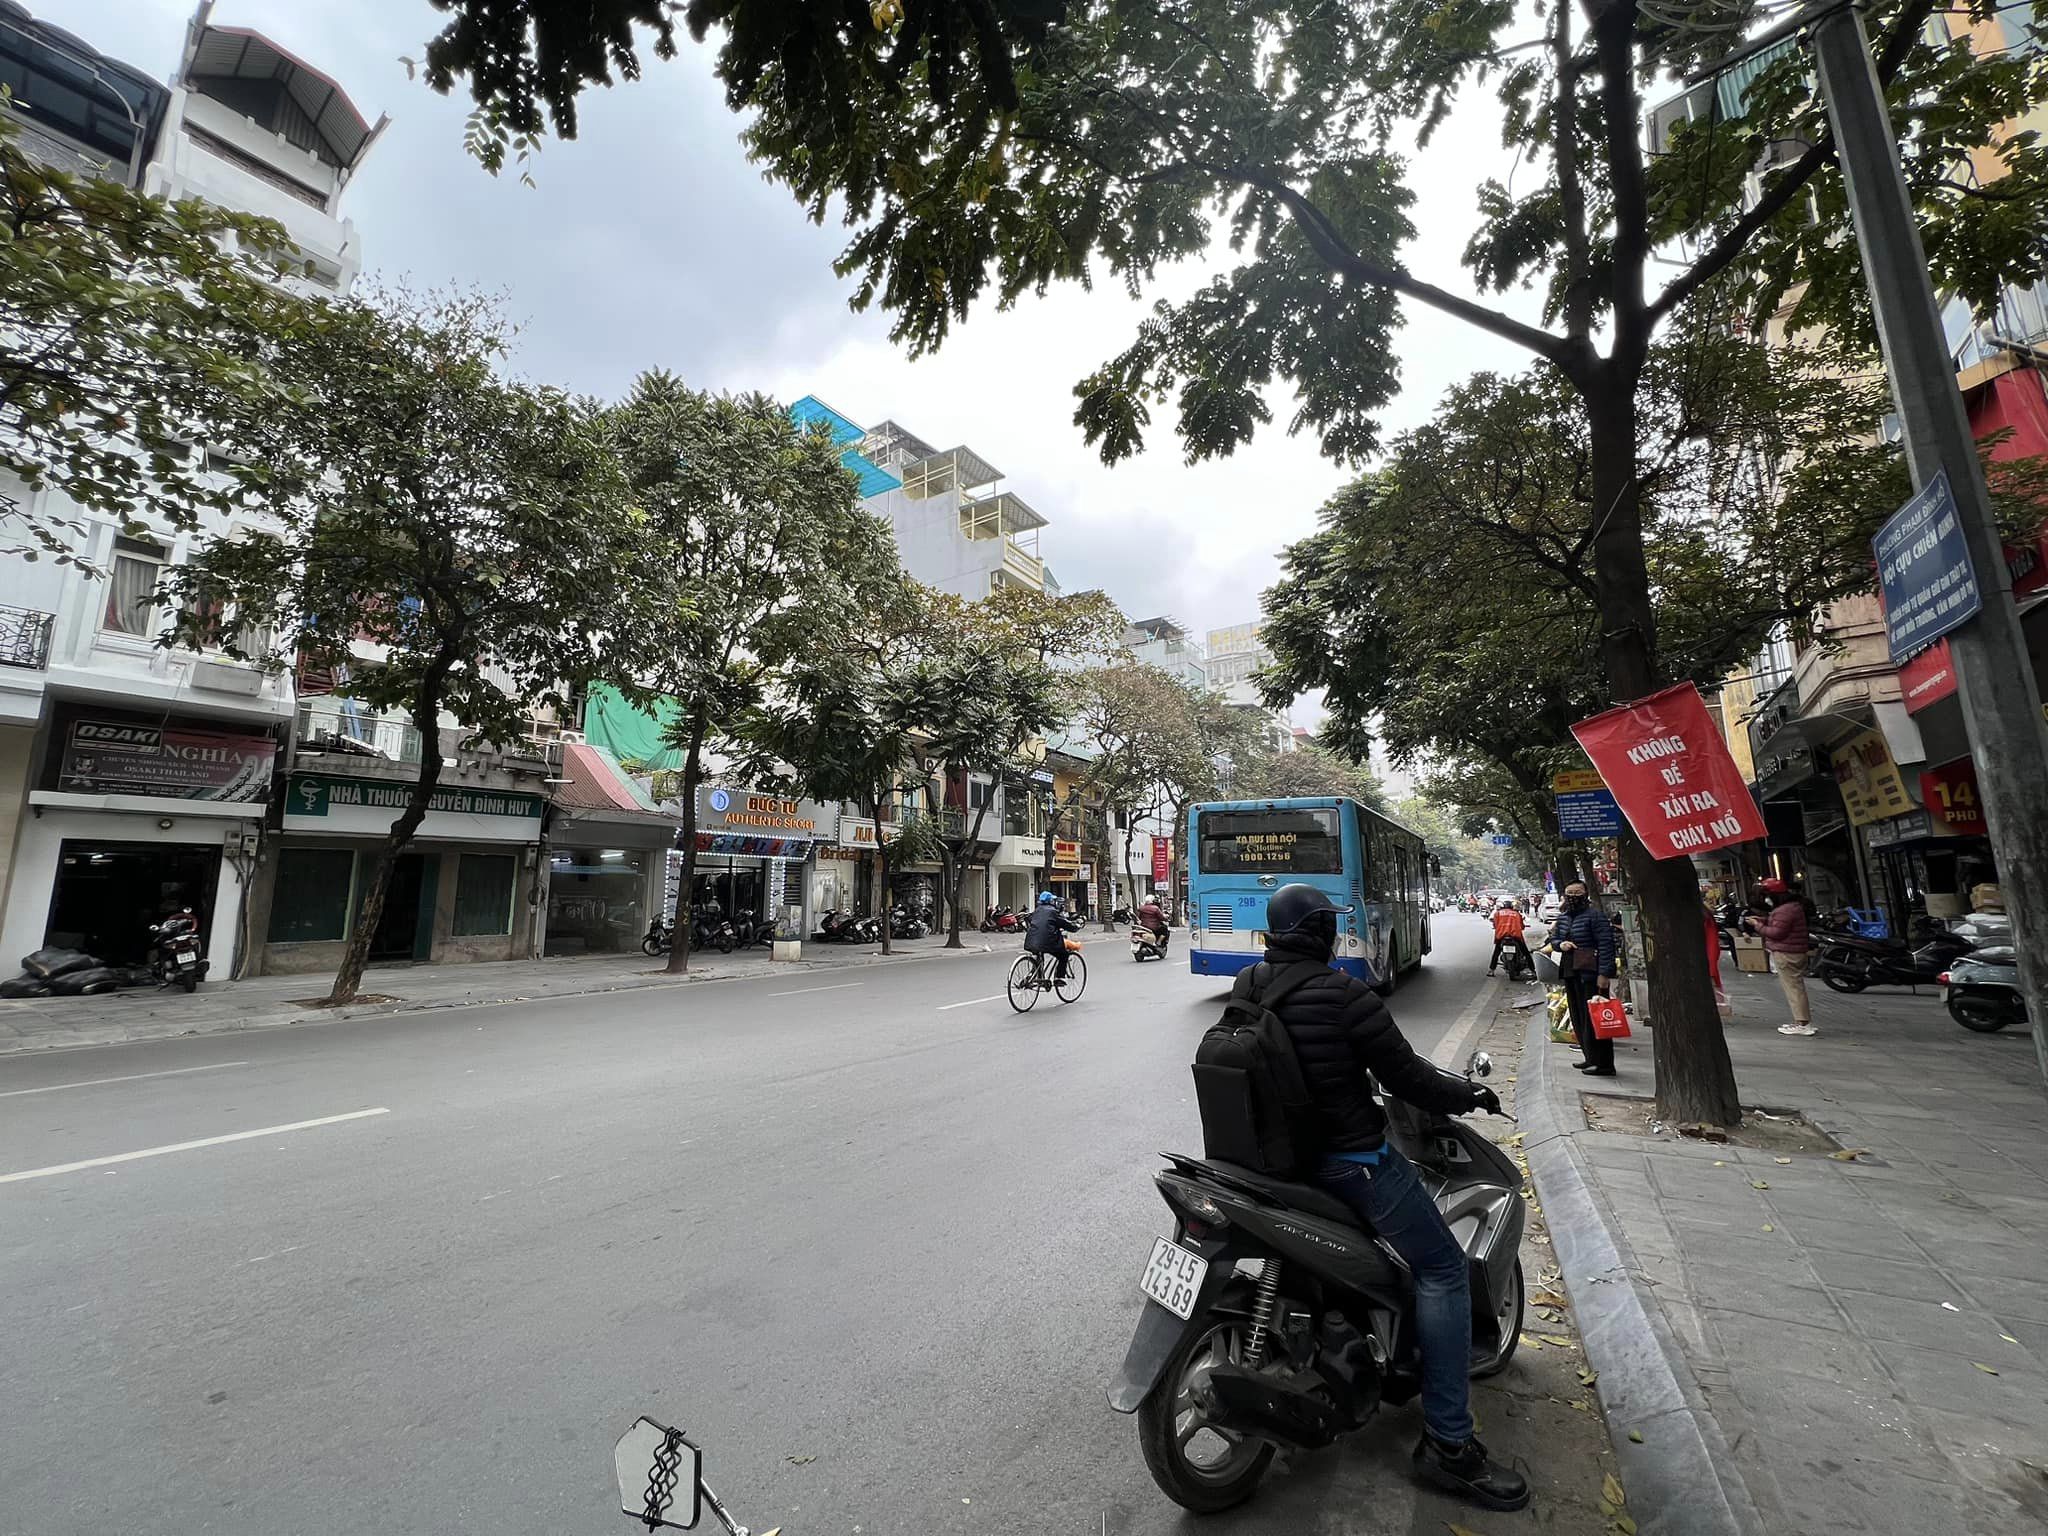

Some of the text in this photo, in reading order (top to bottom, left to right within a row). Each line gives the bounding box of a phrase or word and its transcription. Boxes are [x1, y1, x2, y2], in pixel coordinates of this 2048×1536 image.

[78, 725, 160, 743] OSAKI
[163, 744, 243, 764] NGHĨA
[1626, 735, 1686, 766] KHÔNG
[123, 765, 210, 778] OSAKI THAILAND
[1661, 760, 1685, 786] ĐỂ
[329, 784, 532, 816] NHÀ THUỐC GUYỄN ĐÌNH HUY
[1659, 790, 1719, 819] XẢY RA
[1933, 782, 1975, 808] 14
[725, 812, 782, 827] AUTHENTIC
[784, 817, 816, 830] SPORT
[1668, 808, 1742, 850] CHÁY, NỔ
[1239, 852, 1291, 862] 1900.1296
[1256, 844, 1283, 852] Hotline
[1155, 1243, 1199, 1284] 29-L5
[1144, 1266, 1193, 1314] 143.69
